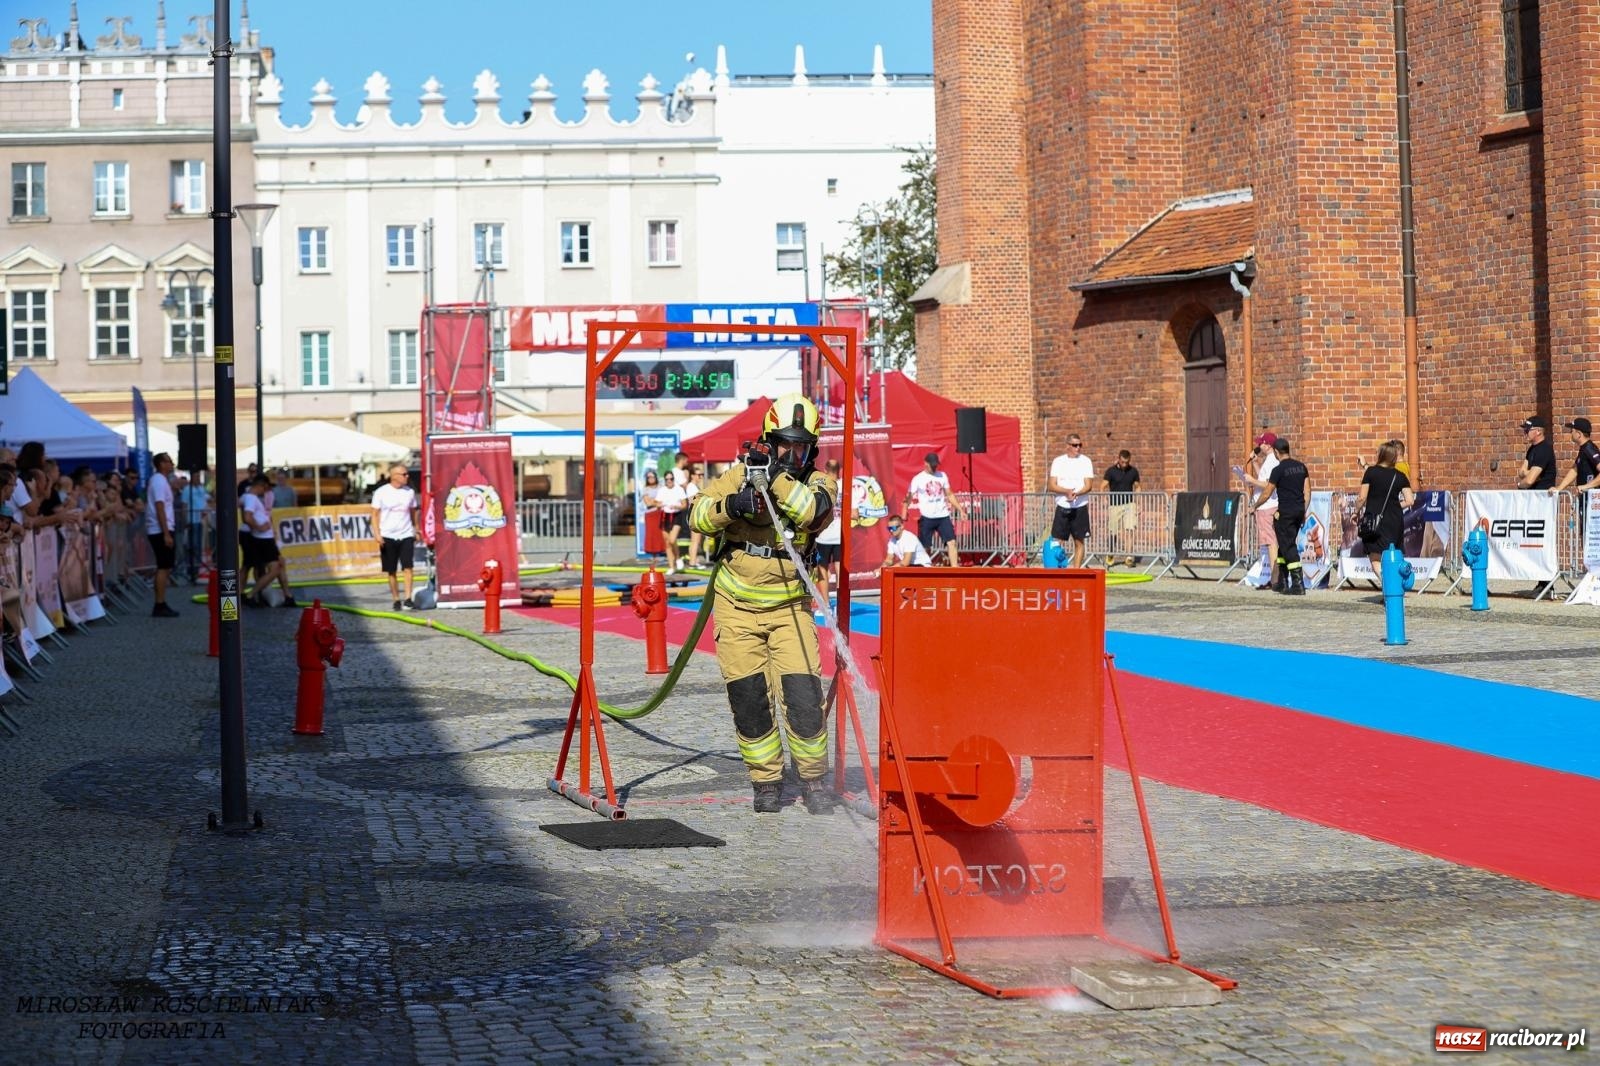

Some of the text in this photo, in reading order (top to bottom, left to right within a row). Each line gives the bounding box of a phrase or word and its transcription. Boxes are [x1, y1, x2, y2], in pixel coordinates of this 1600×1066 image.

[692, 308, 800, 343] META
[665, 373, 731, 390] 2:34.50
[279, 516, 374, 544] GRAN-MIX
[1204, 535, 1231, 550] RACIBÓRZ
